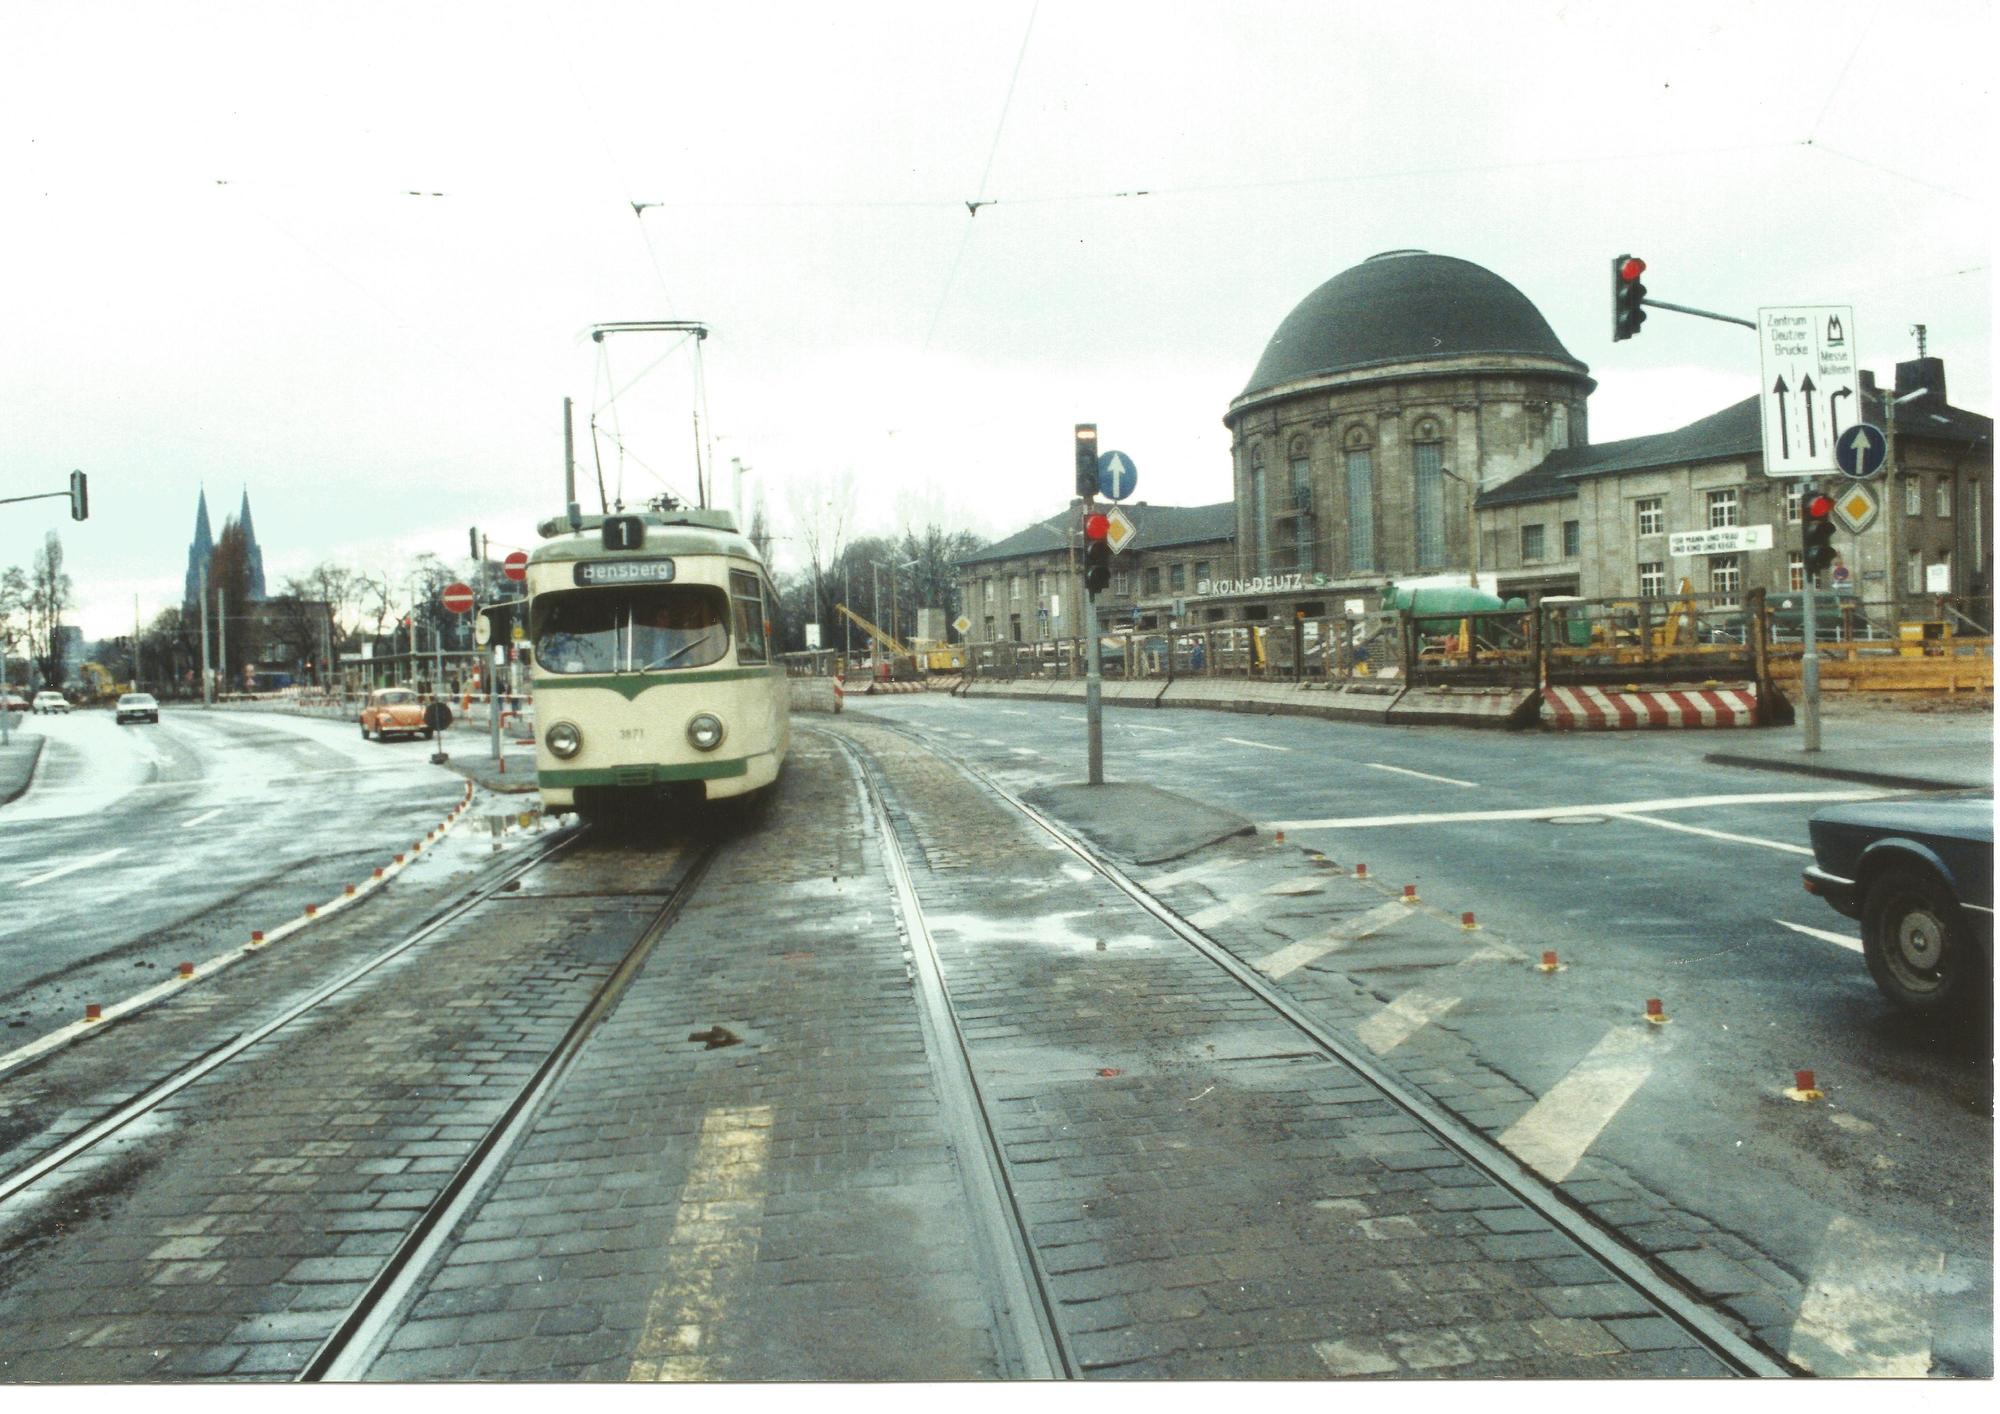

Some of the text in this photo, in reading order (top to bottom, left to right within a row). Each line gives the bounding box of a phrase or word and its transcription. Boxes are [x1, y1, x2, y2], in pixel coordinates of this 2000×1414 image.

[1767, 314, 1806, 327] Zentrum
[1771, 328, 1807, 341] Deutzer
[619, 521, 627, 546] 1
[1315, 573, 1324, 584] S
